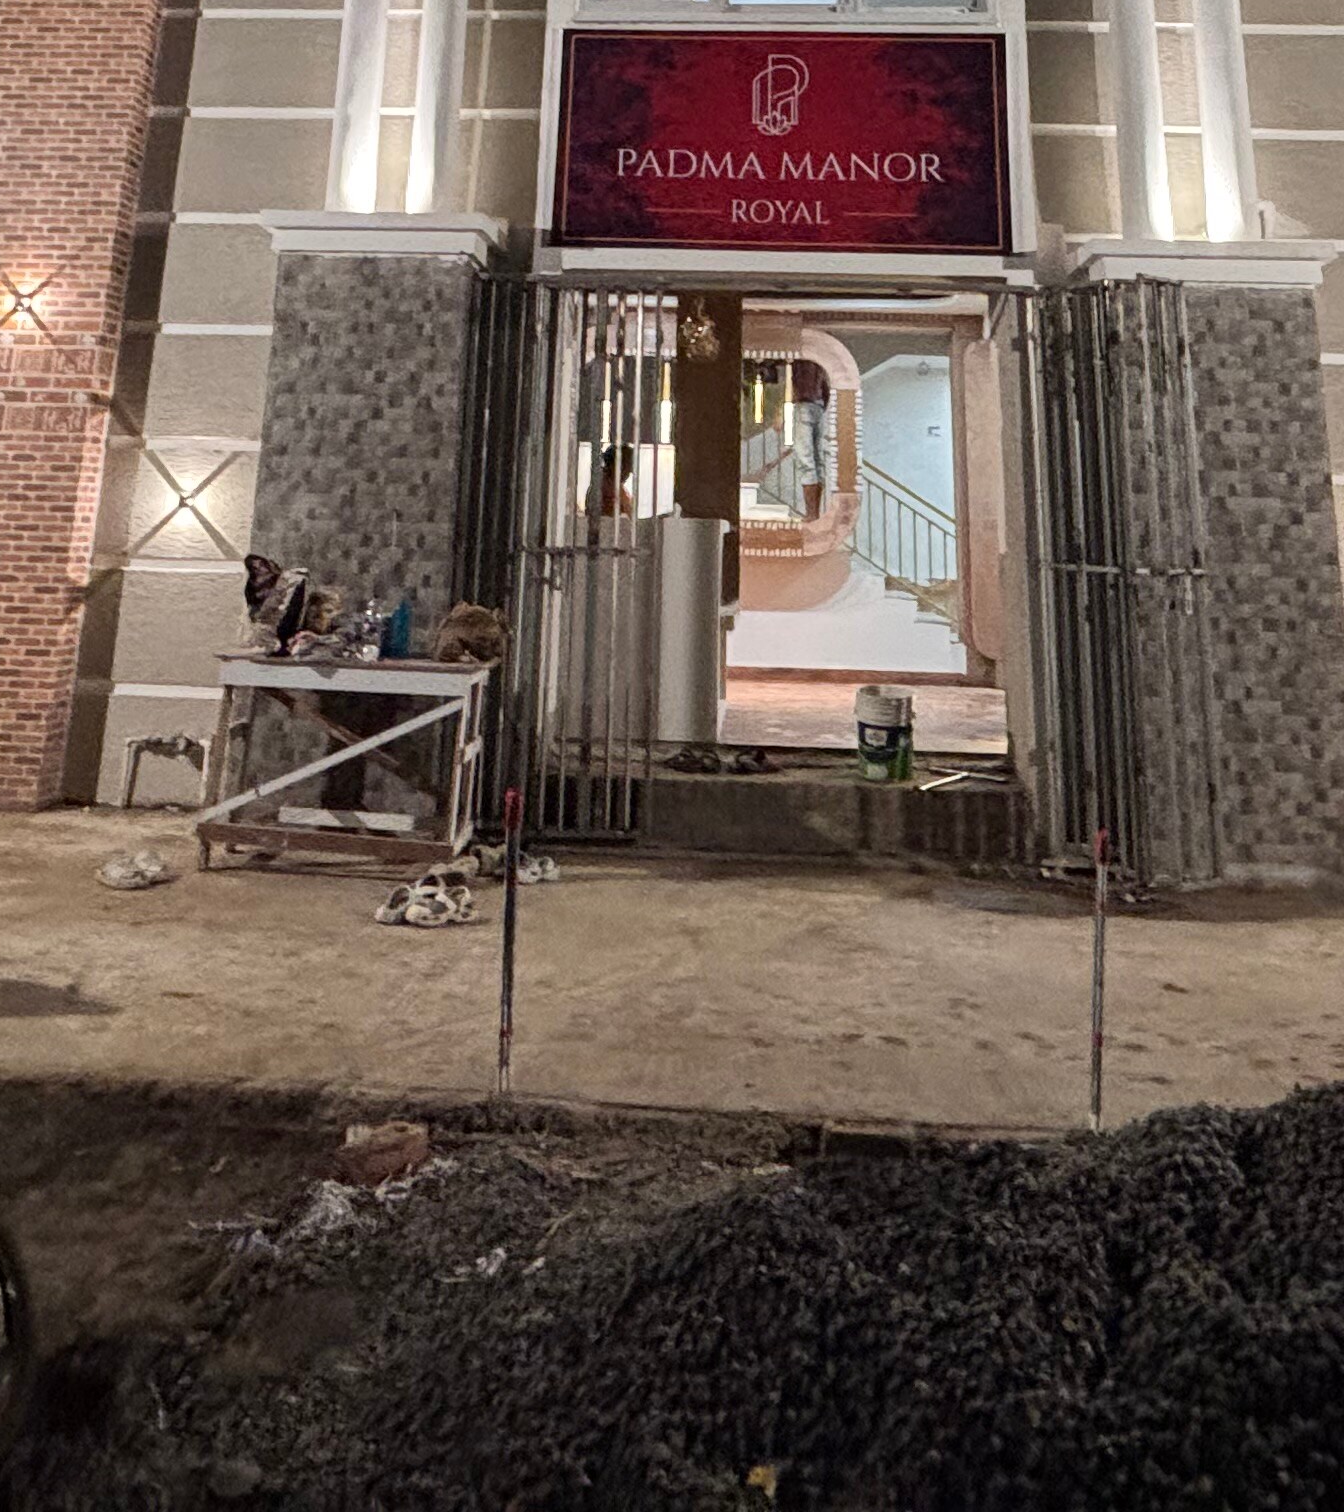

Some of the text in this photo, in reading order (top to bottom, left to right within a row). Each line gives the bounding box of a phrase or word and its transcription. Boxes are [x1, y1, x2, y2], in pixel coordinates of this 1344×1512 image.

[616, 148, 945, 184] PADMA MANOR
[731, 199, 830, 225] ROYAL
